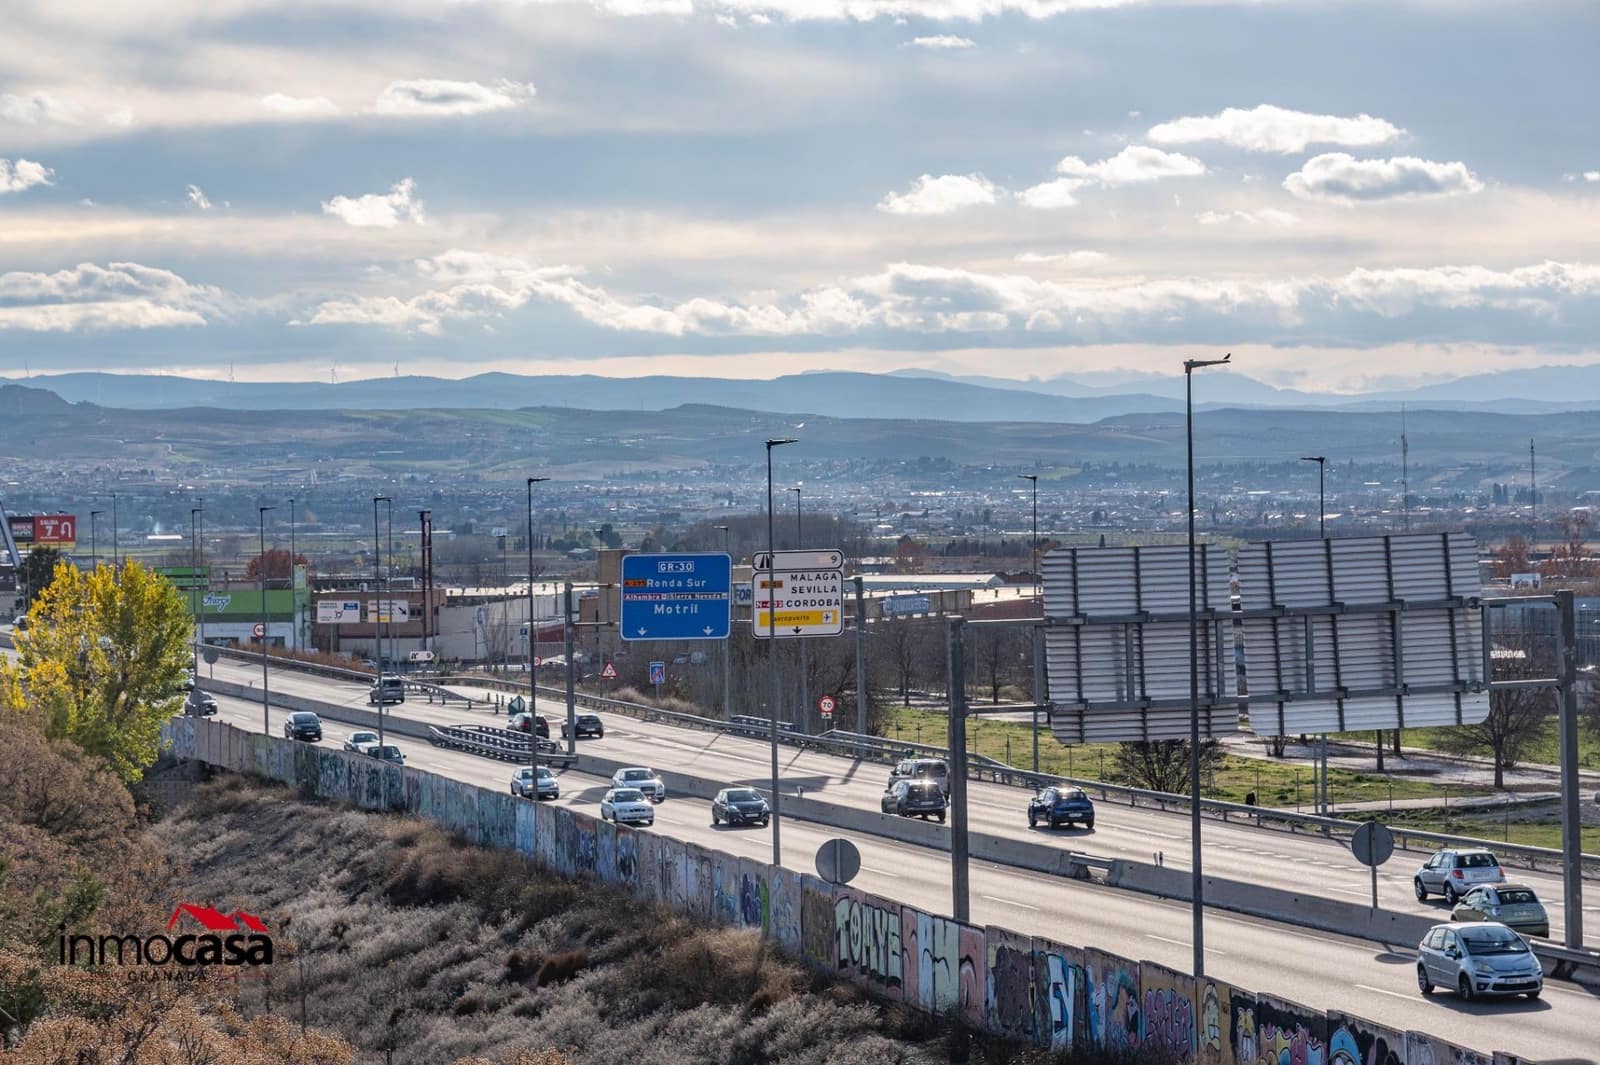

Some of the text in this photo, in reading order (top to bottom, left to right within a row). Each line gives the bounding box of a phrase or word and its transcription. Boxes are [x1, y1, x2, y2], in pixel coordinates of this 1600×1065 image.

[45, 525, 53, 537] 7
[659, 562, 693, 571] GR-30
[790, 572, 838, 582] MALAGA
[646, 578, 682, 588] Ronda
[687, 578, 707, 588] Sur
[791, 585, 838, 595] SEVILLA
[624, 593, 660, 601] Alhambra
[786, 598, 841, 608] CORDOBA
[654, 603, 698, 615] Motril
[821, 700, 833, 710] 70
